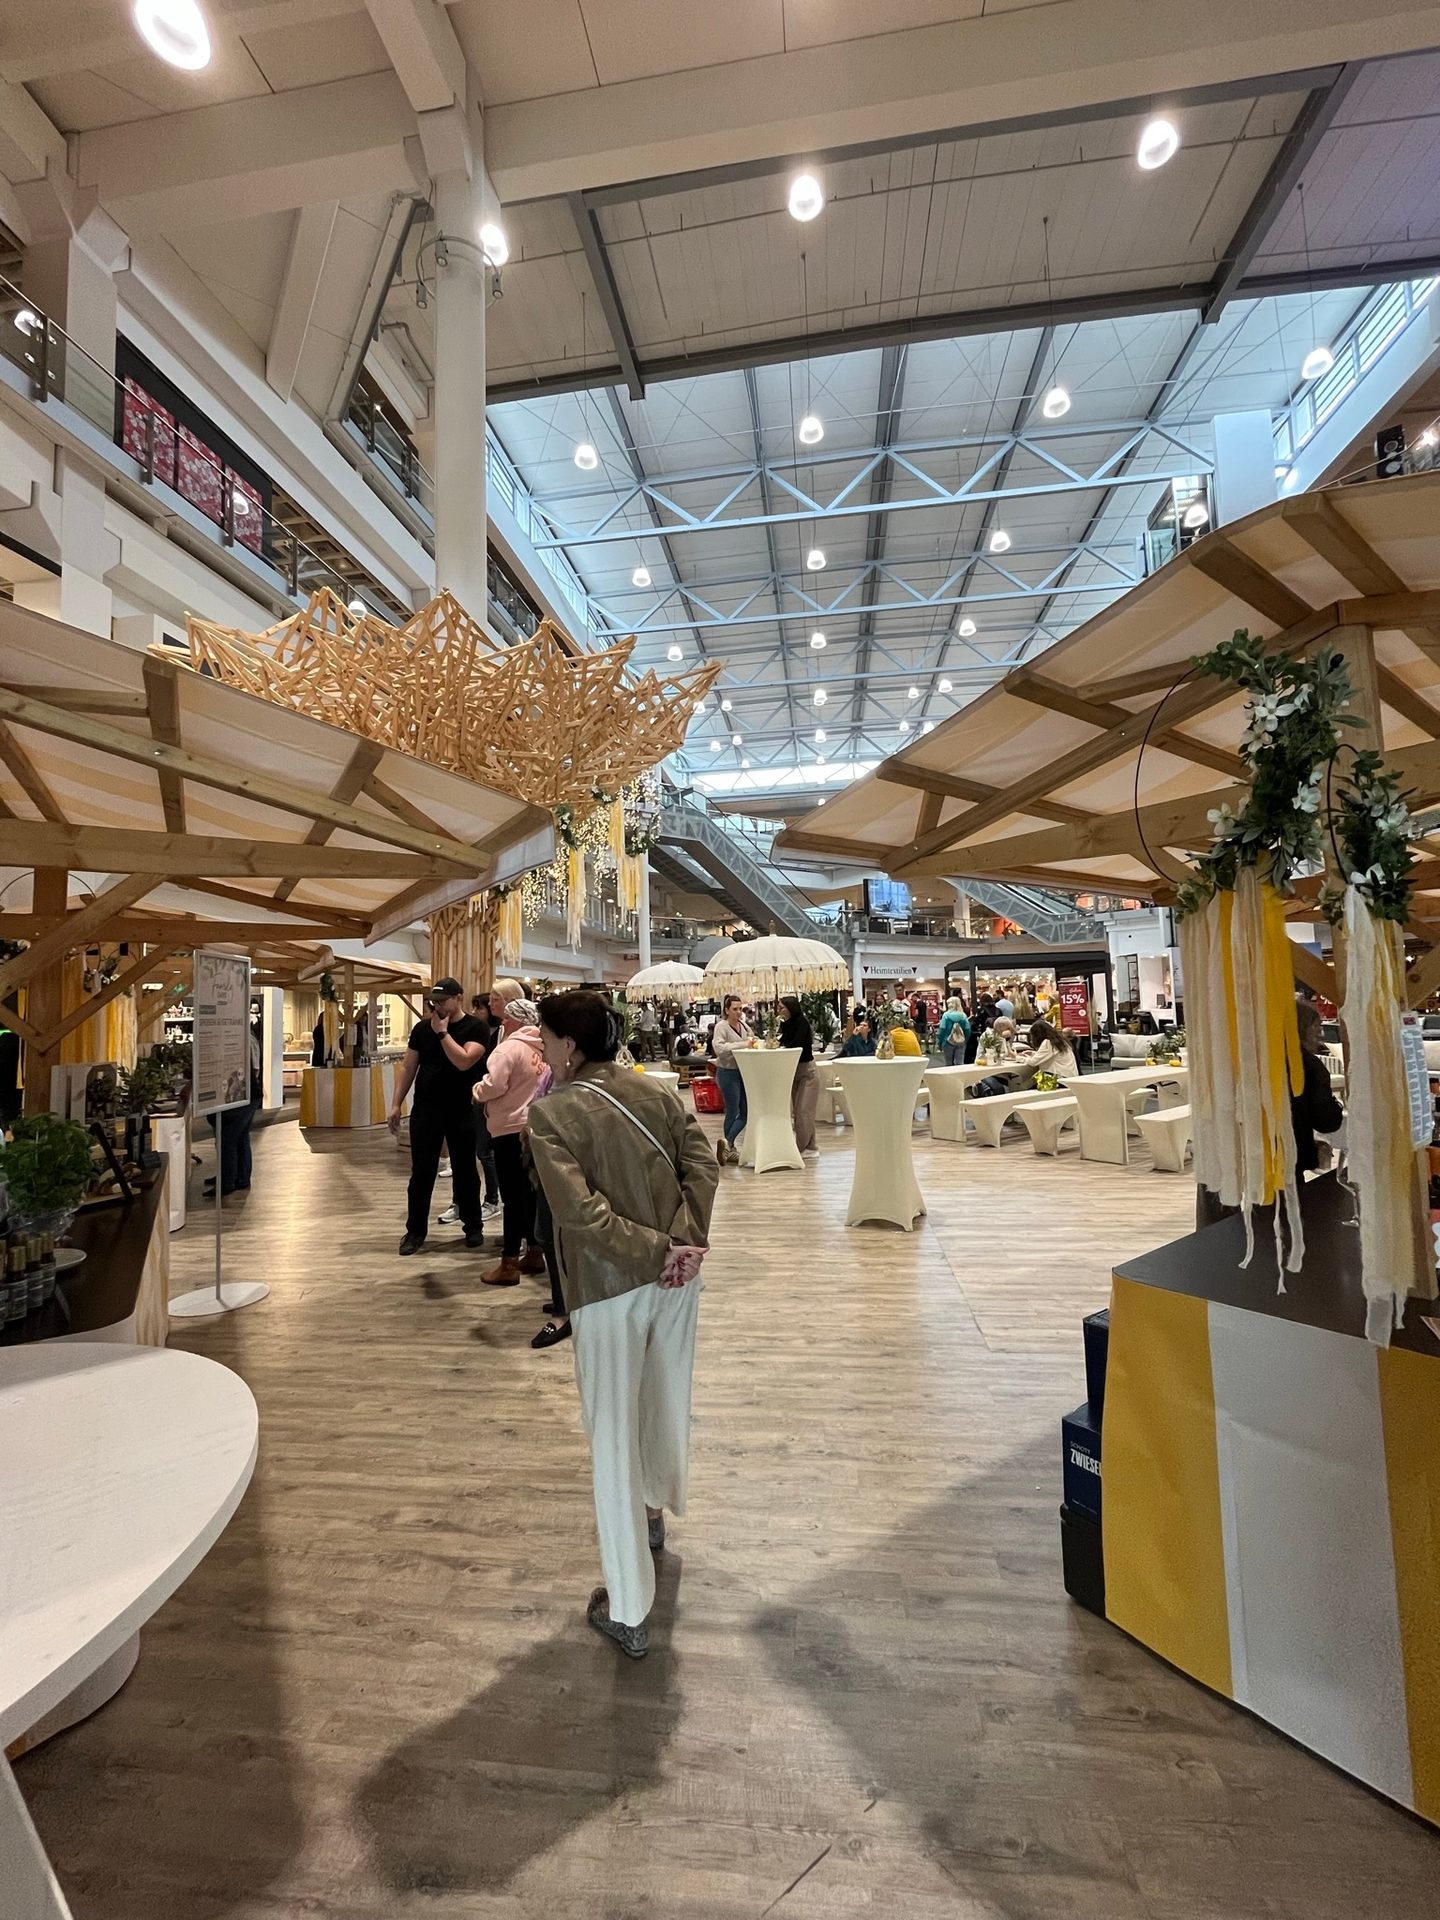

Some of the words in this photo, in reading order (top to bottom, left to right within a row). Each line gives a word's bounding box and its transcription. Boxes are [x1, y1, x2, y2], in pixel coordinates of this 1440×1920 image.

[870, 966, 912, 975] Heimtextilien
[1060, 993, 1085, 1005] 15%
[1070, 1440, 1091, 1455] SCHOTT
